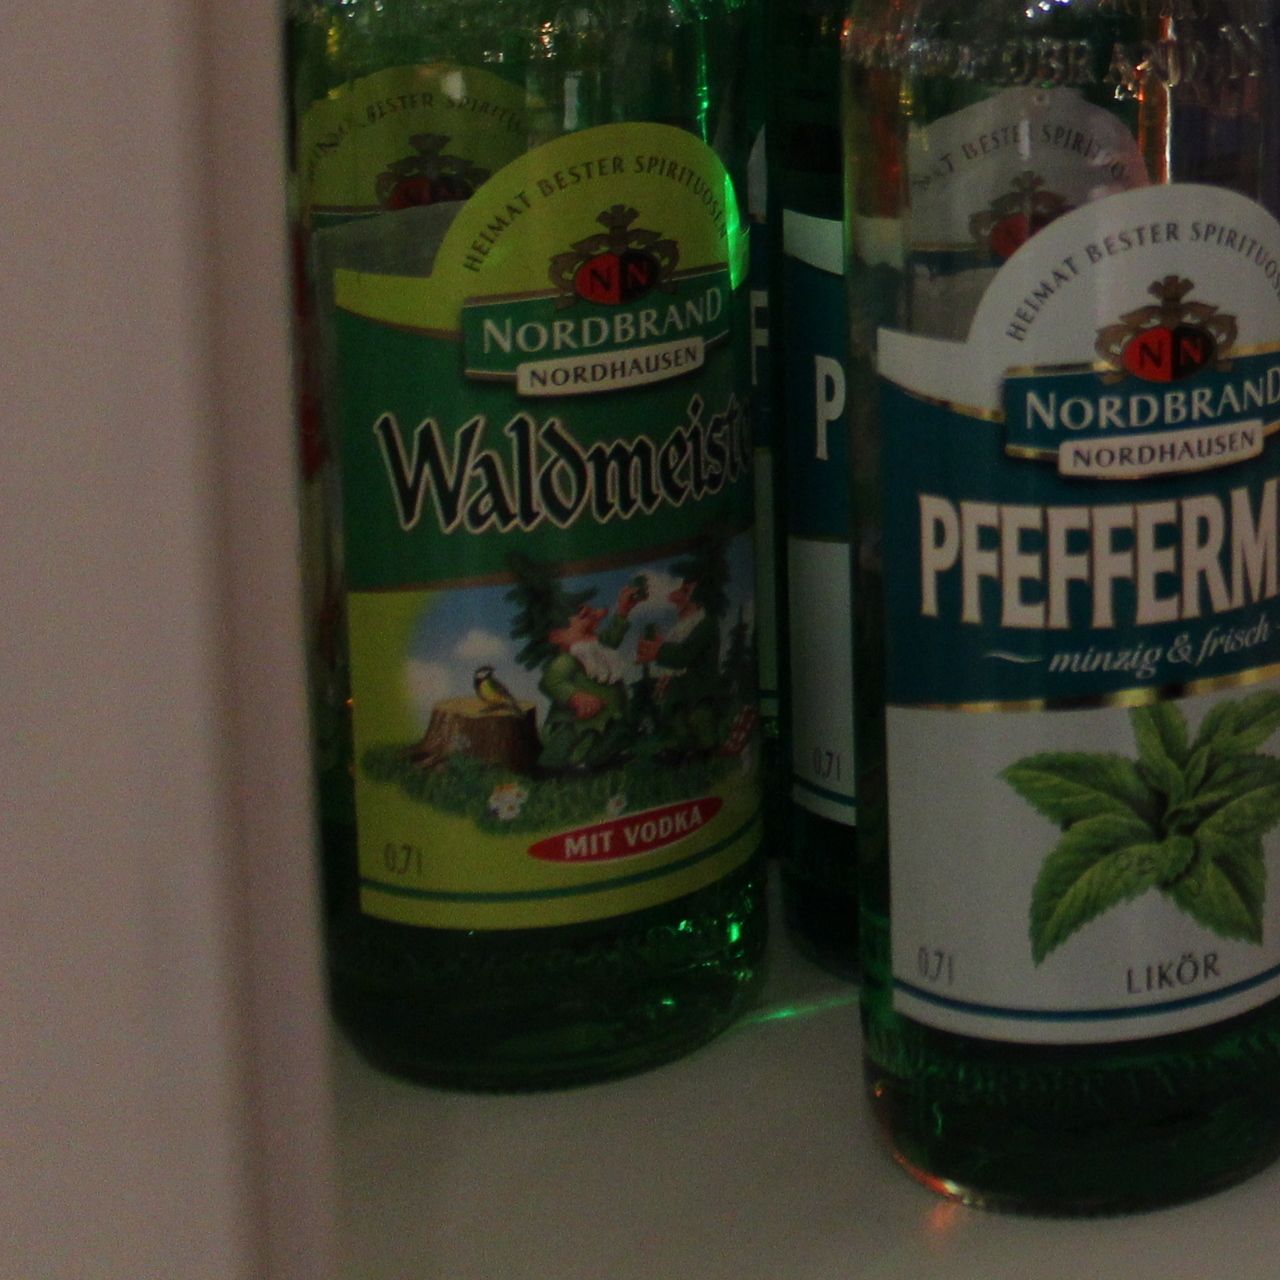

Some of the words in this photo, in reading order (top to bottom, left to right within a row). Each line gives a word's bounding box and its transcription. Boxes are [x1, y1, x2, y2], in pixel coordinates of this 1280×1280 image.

[961, 124, 1032, 161] BESTE
[463, 191, 532, 273] HEIMAT
[536, 155, 625, 199] BESTER
[1005, 255, 1081, 342] HEIMAT
[1085, 221, 1180, 265] BESTER
[480, 286, 724, 356] NORDBRAND
[528, 345, 698, 388] NORDHAUSEN
[1072, 428, 1257, 468] NORDHAUSEN
[1048, 642, 1161, 680] minzig
[1166, 630, 1194, 666] &
[1194, 612, 1271, 666] frisch
[563, 825, 618, 862] MIT
[621, 804, 706, 848] VODKA
[1125, 952, 1222, 996] LIKÖR
